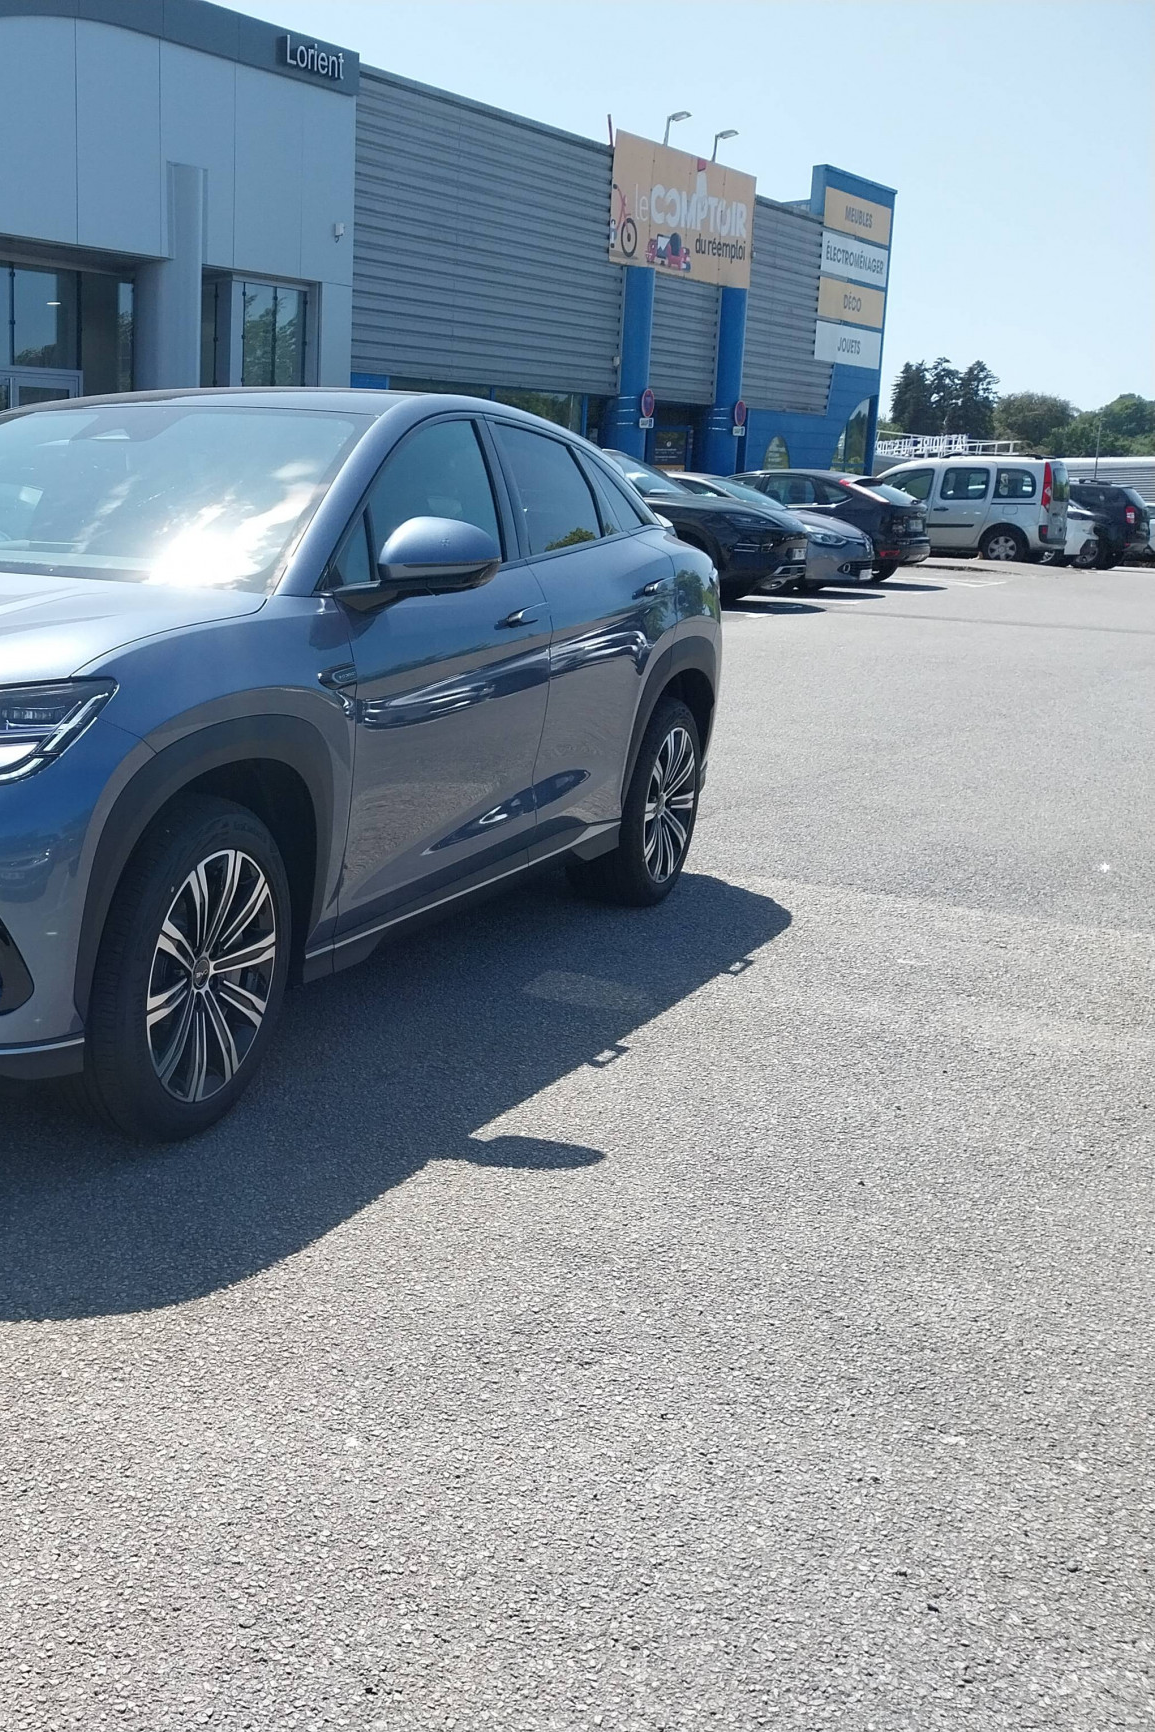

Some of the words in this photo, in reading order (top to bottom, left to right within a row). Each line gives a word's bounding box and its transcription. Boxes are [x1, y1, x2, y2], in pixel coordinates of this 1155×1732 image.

[286, 34, 344, 80] Lorient
[635, 183, 648, 221] le
[650, 183, 747, 238] COMPTOIR
[845, 205, 873, 229] MEUBLES
[695, 233, 706, 256] du
[707, 237, 746, 264] réemploi
[826, 240, 884, 274] ÉLECTROMÉNAGER
[843, 291, 862, 312] DÉCO
[837, 337, 861, 355] JOUETS
